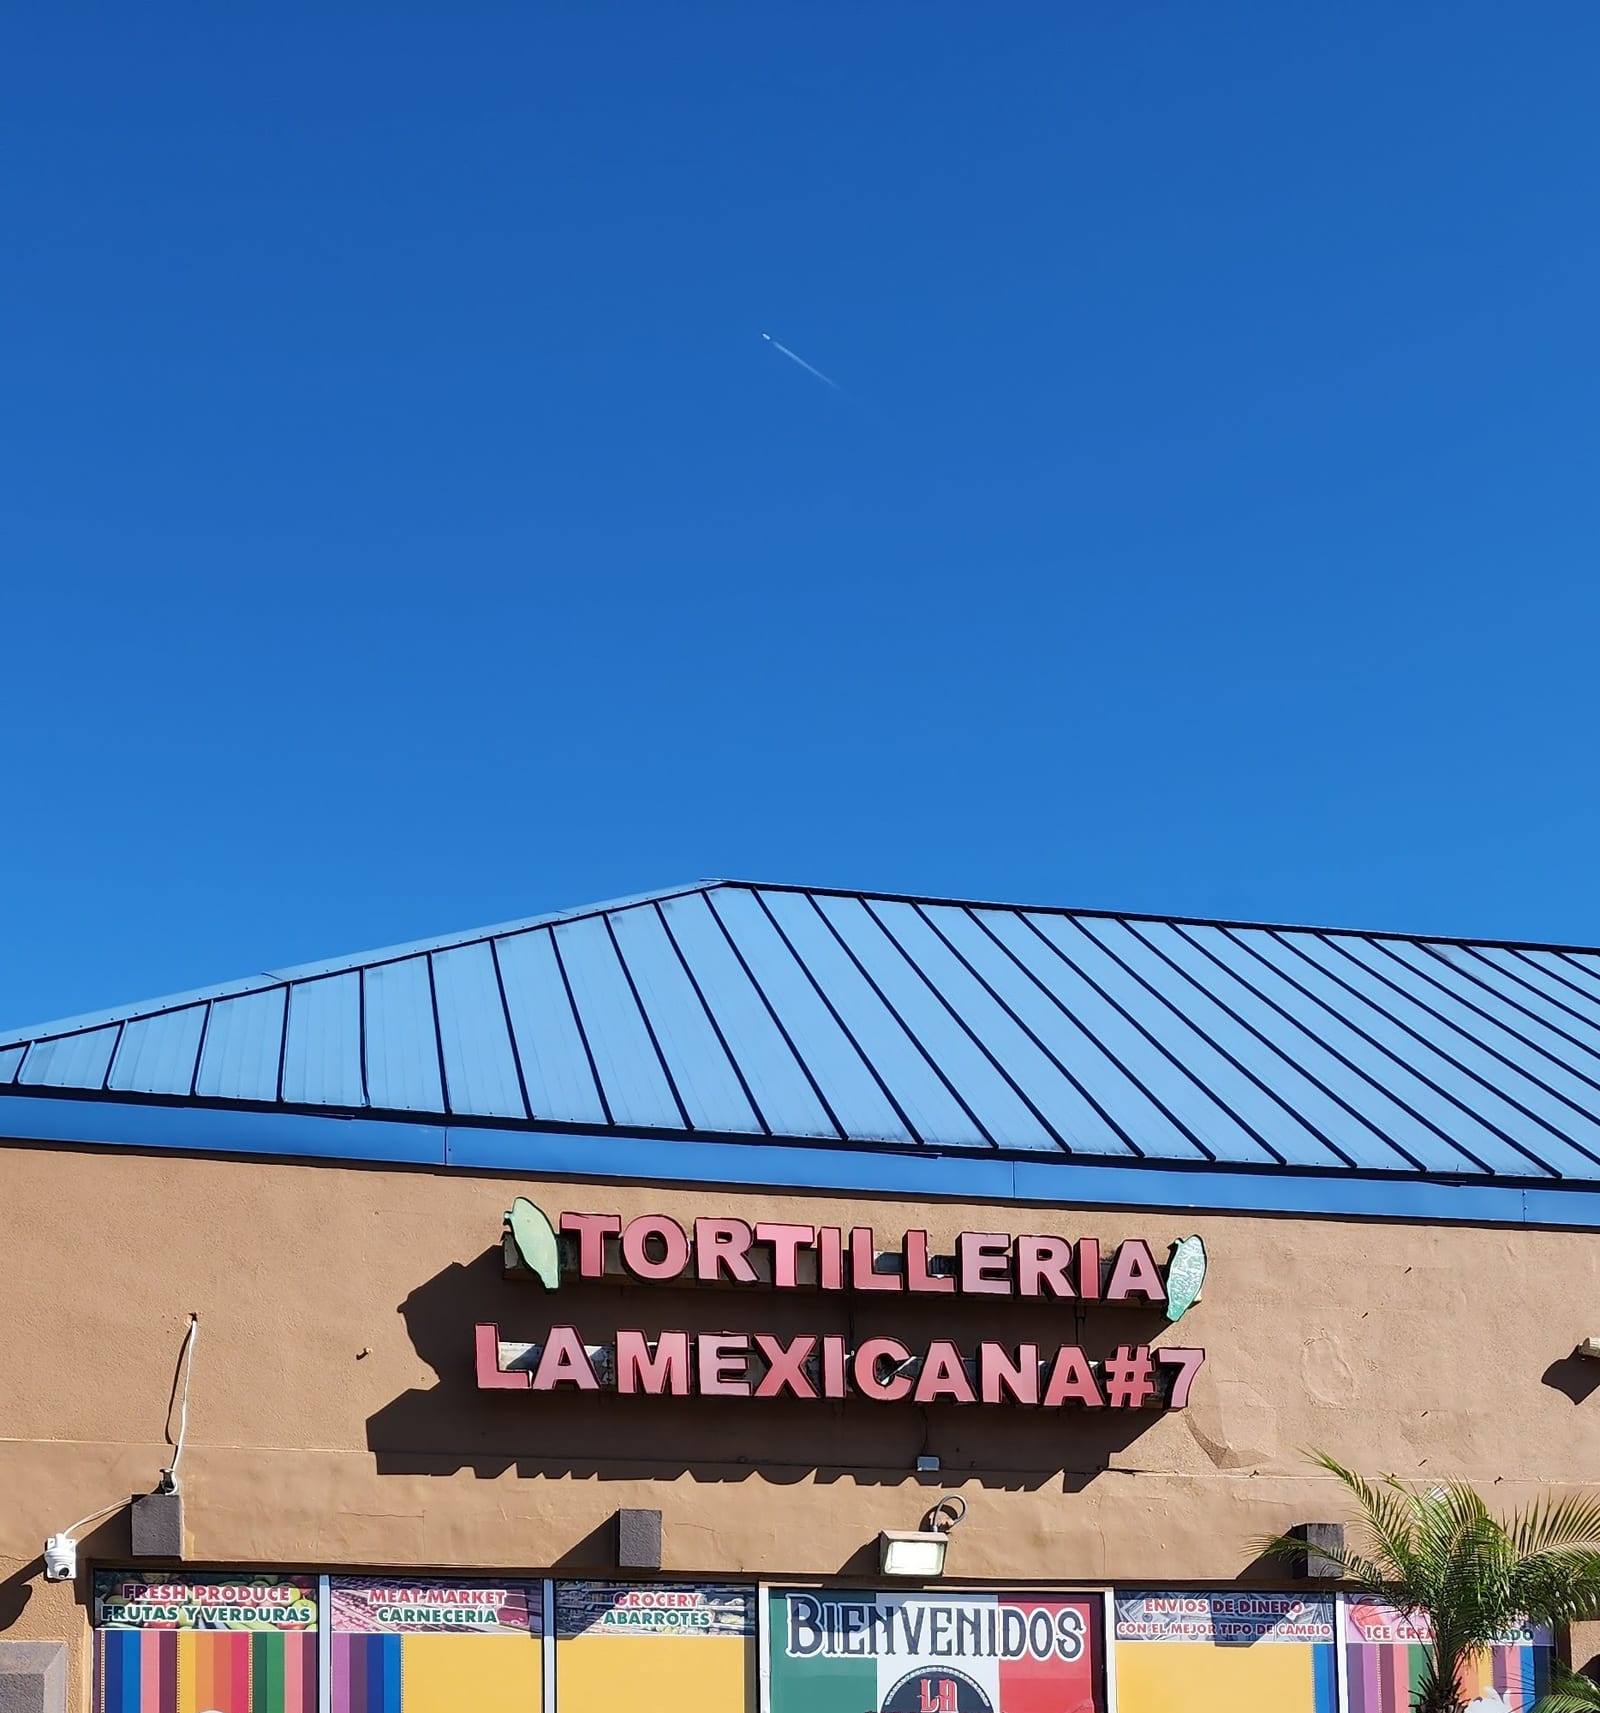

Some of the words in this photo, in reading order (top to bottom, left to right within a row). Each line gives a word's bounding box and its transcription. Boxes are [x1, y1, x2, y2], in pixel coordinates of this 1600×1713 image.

[561, 1213, 1166, 1301] TORTILLERIA
[475, 1322, 600, 1391] LA
[123, 1584, 187, 1600] FRESH
[193, 1585, 290, 1601] PRODUCE
[368, 1589, 421, 1604] MEAT
[427, 1590, 506, 1604] MARKET
[613, 1592, 701, 1607] GROCERY
[101, 1605, 179, 1621] FRUTAS
[183, 1605, 200, 1622] Y
[201, 1606, 311, 1622] VERDURAS
[1212, 1600, 1235, 1613] DE
[1239, 1600, 1304, 1614] DINERO
[602, 1609, 711, 1627] ABARROTES
[786, 1593, 1087, 1661] BIENVENIDOS
[1117, 1621, 1147, 1634] CON
[1151, 1622, 1167, 1634] EL
[1170, 1622, 1216, 1634] MEJOR
[1220, 1622, 1251, 1635] TIPO
[1256, 1622, 1274, 1635] DE
[1278, 1623, 1332, 1635] CAMBIO
[1366, 1625, 1391, 1640] ICE
[917, 1679, 959, 1713] LA
